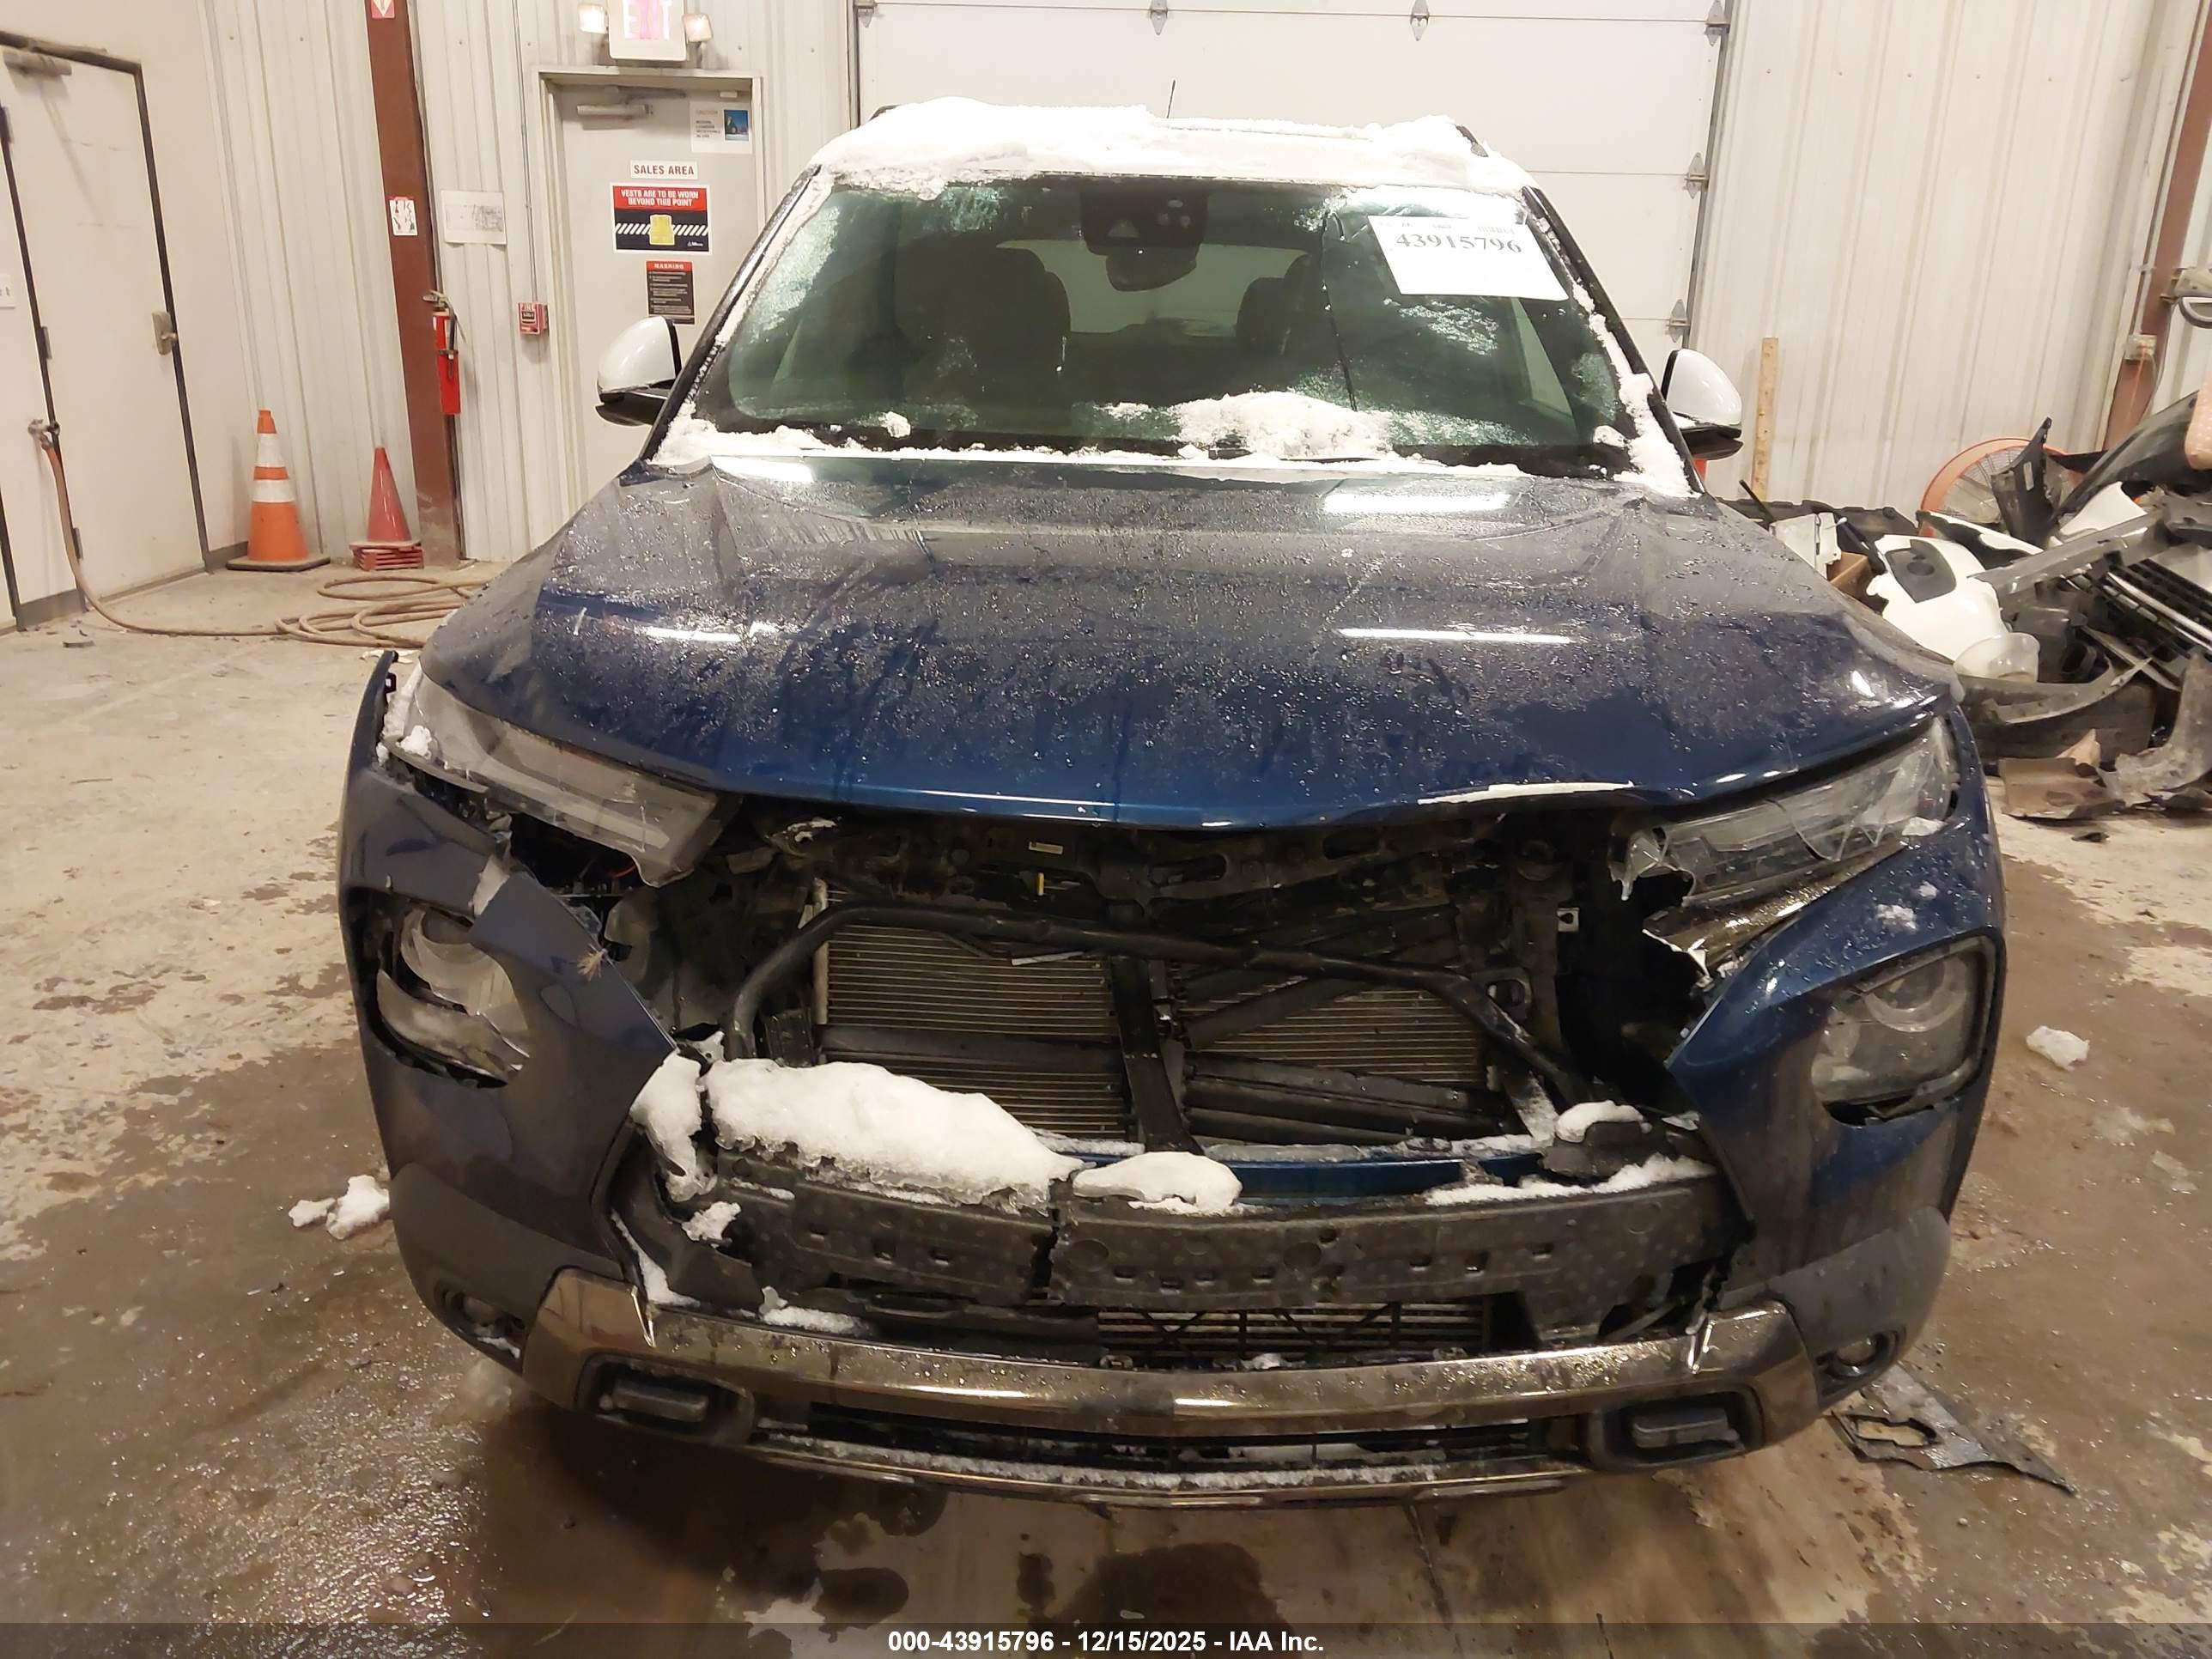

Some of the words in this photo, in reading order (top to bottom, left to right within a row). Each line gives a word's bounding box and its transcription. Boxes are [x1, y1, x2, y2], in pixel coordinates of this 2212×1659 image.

[622, 0, 672, 40] EXIT
[634, 164, 665, 174] SALES
[668, 165, 694, 175] AREA
[621, 189, 642, 198] VESTS
[643, 190, 656, 198] ARE
[678, 191, 699, 199] WORN
[628, 198, 655, 206] BEYOND
[656, 198, 671, 206] THIS
[672, 198, 693, 207] POINT
[1395, 233, 1522, 253] 43915796
